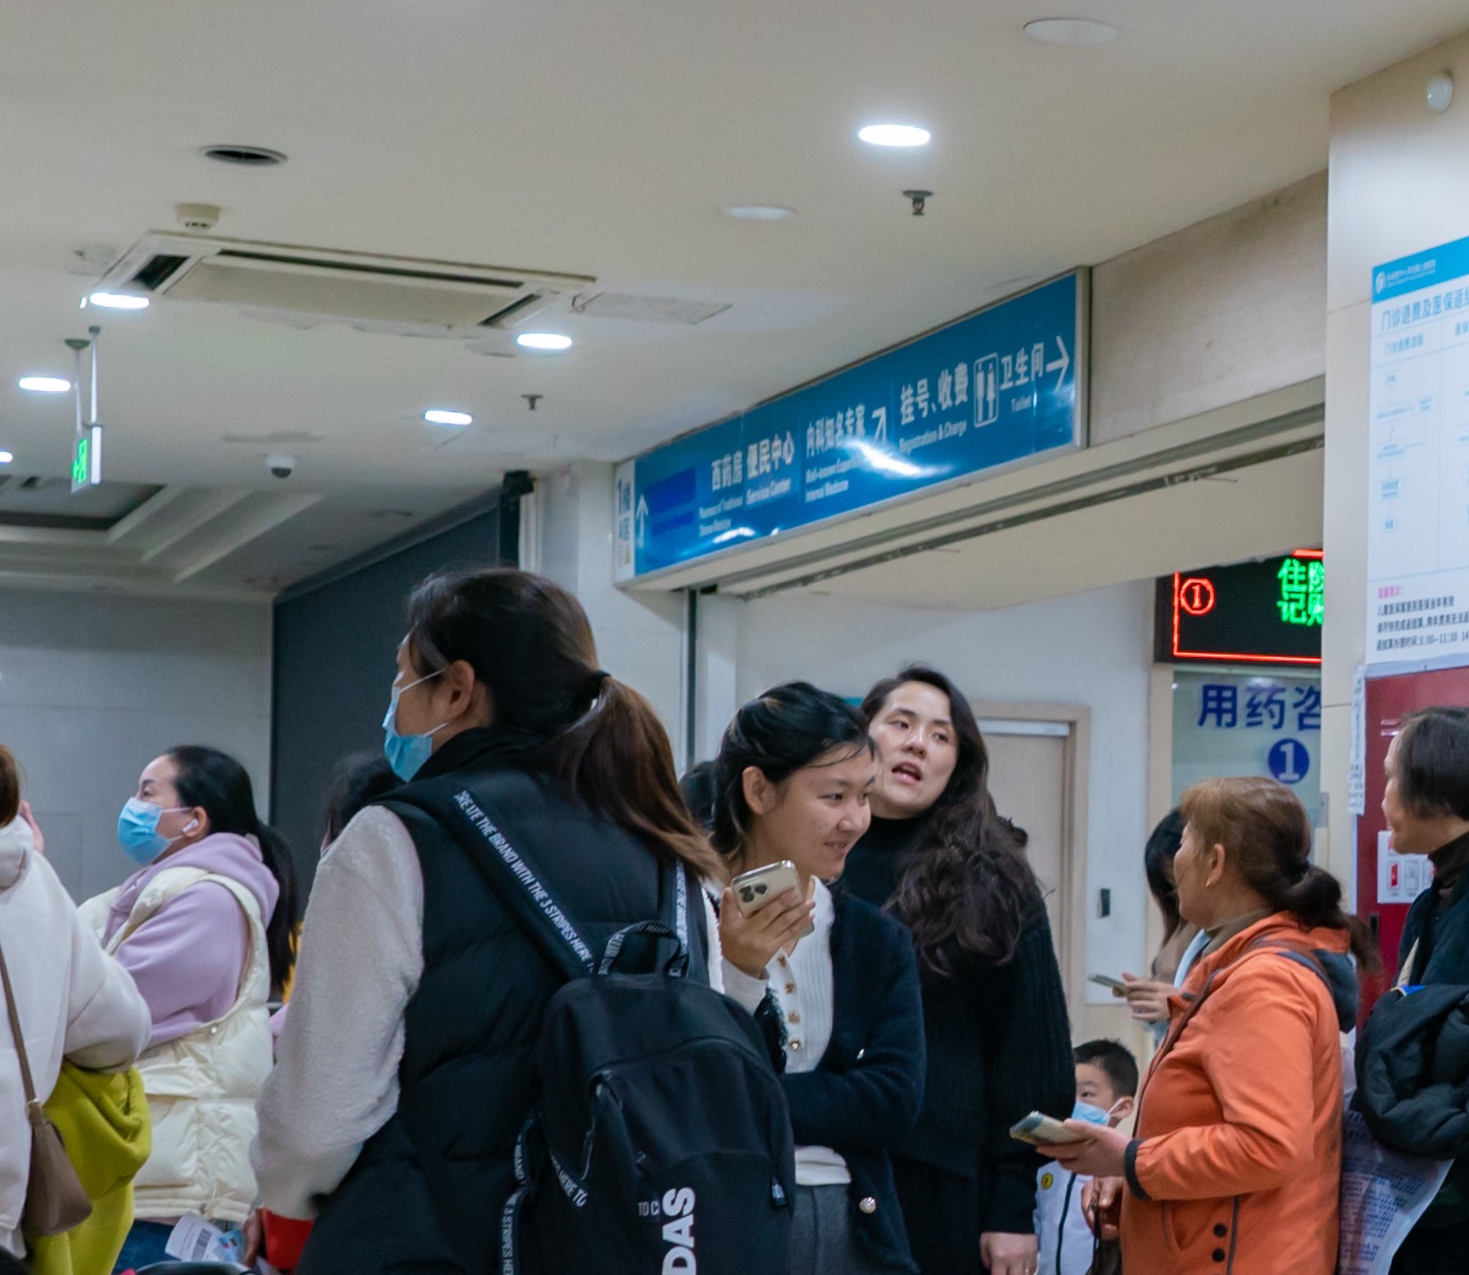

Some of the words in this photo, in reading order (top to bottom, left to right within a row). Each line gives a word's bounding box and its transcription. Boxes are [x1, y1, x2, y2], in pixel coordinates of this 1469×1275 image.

[711, 450, 743, 492] 西药房
[747, 431, 795, 479] 便民中心
[806, 403, 865, 458] 内科知名专家
[900, 362, 969, 426] 挂号、收费
[1000, 342, 1044, 391] 卫生间
[1198, 684, 1321, 732] 用药咨
[476, 817, 496, 838] THE
[489, 831, 519, 863] BRAND
[511, 858, 535, 886] WITH
[528, 880, 548, 903] THE
[545, 903, 577, 941] STRIPES
[502, 1216, 513, 1258] STRIPES
